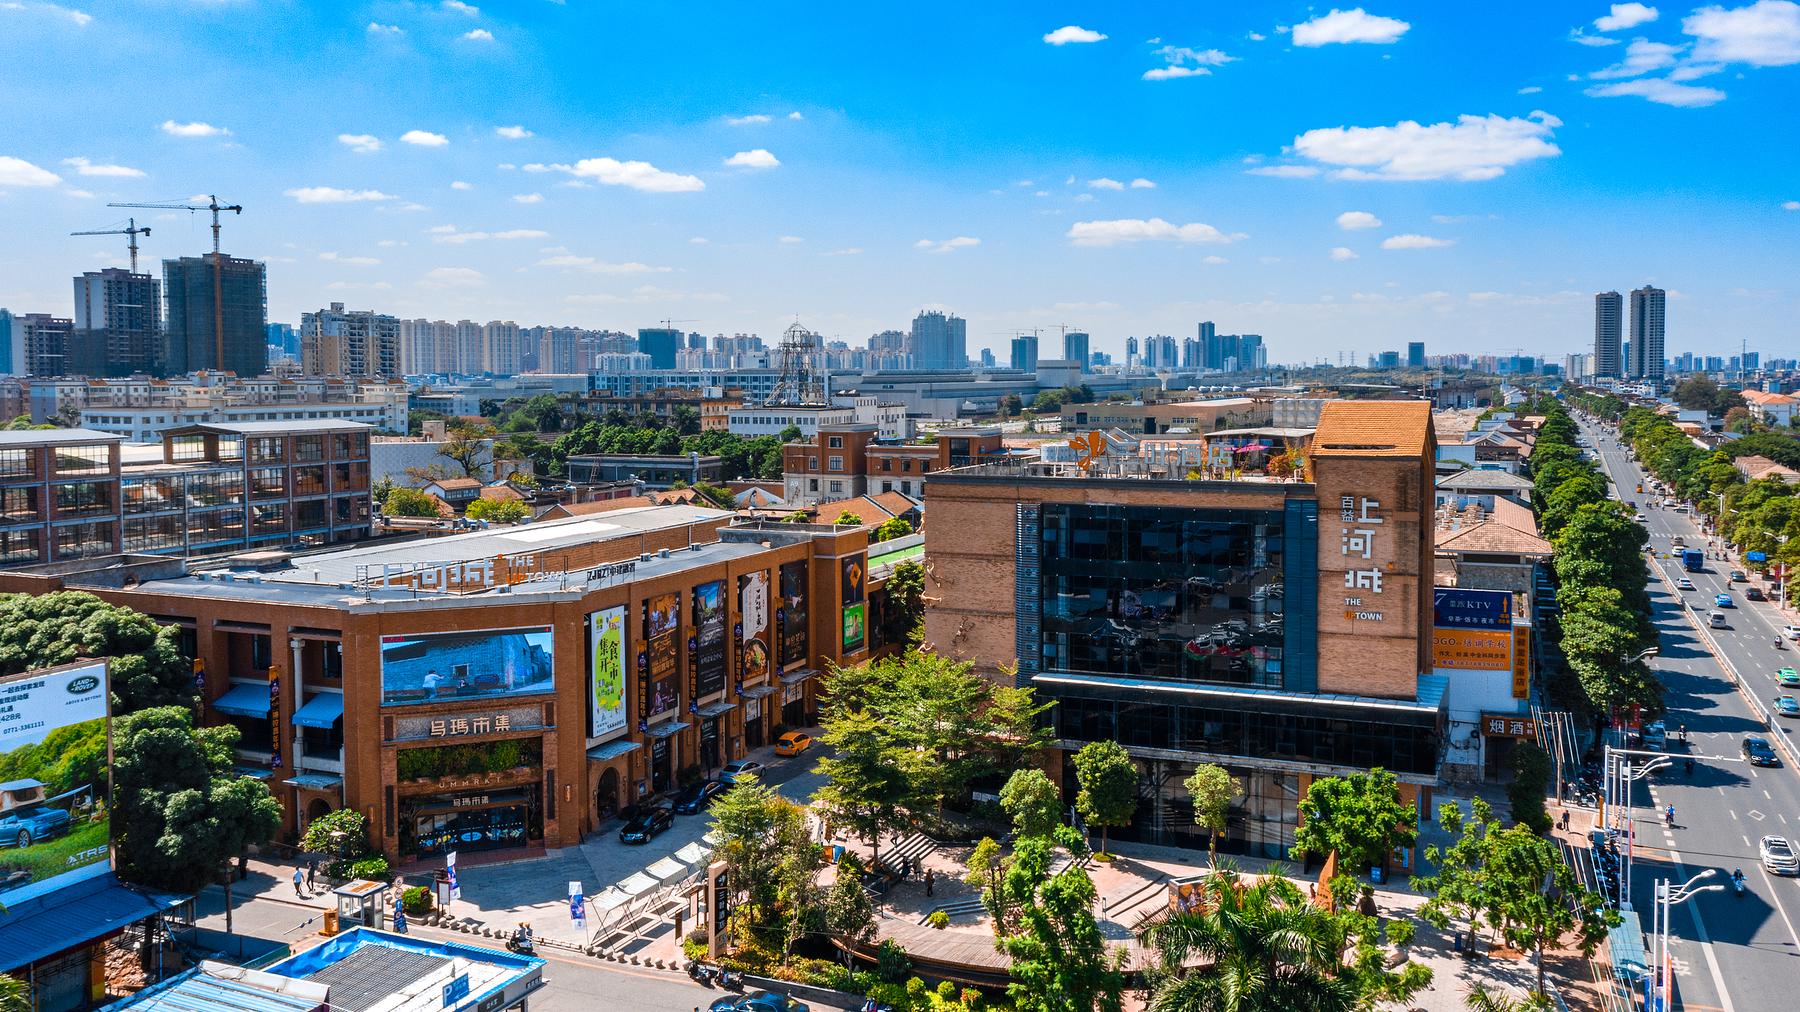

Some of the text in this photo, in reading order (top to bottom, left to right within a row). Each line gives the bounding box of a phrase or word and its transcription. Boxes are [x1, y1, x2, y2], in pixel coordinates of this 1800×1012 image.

[1341, 497, 1384, 594] 上河城
[505, 555, 534, 568] THE
[506, 570, 568, 584] UPTOWN
[1344, 598, 1361, 606] THE
[1489, 719, 1525, 735] 烟酒
[443, 984, 452, 1008] P
